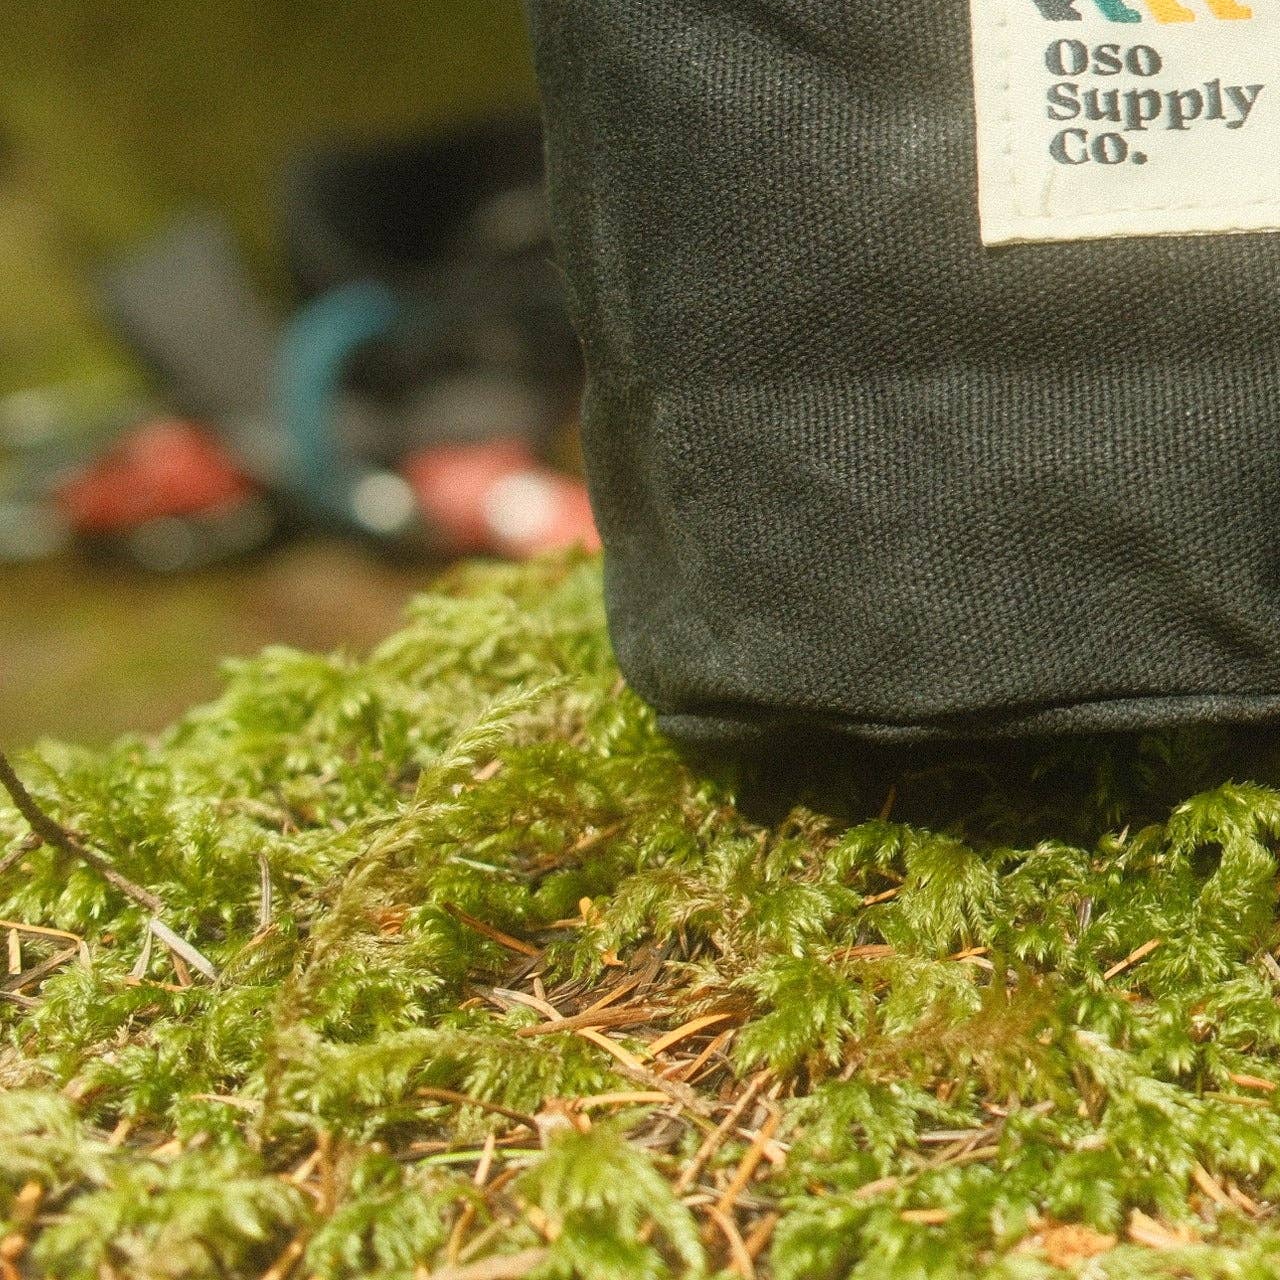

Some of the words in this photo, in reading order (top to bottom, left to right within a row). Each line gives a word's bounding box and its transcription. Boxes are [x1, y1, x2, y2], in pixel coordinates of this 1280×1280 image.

[1044, 38, 1163, 77] Oso
[1046, 77, 1264, 131] Supply
[1049, 126, 1149, 165] Co.
